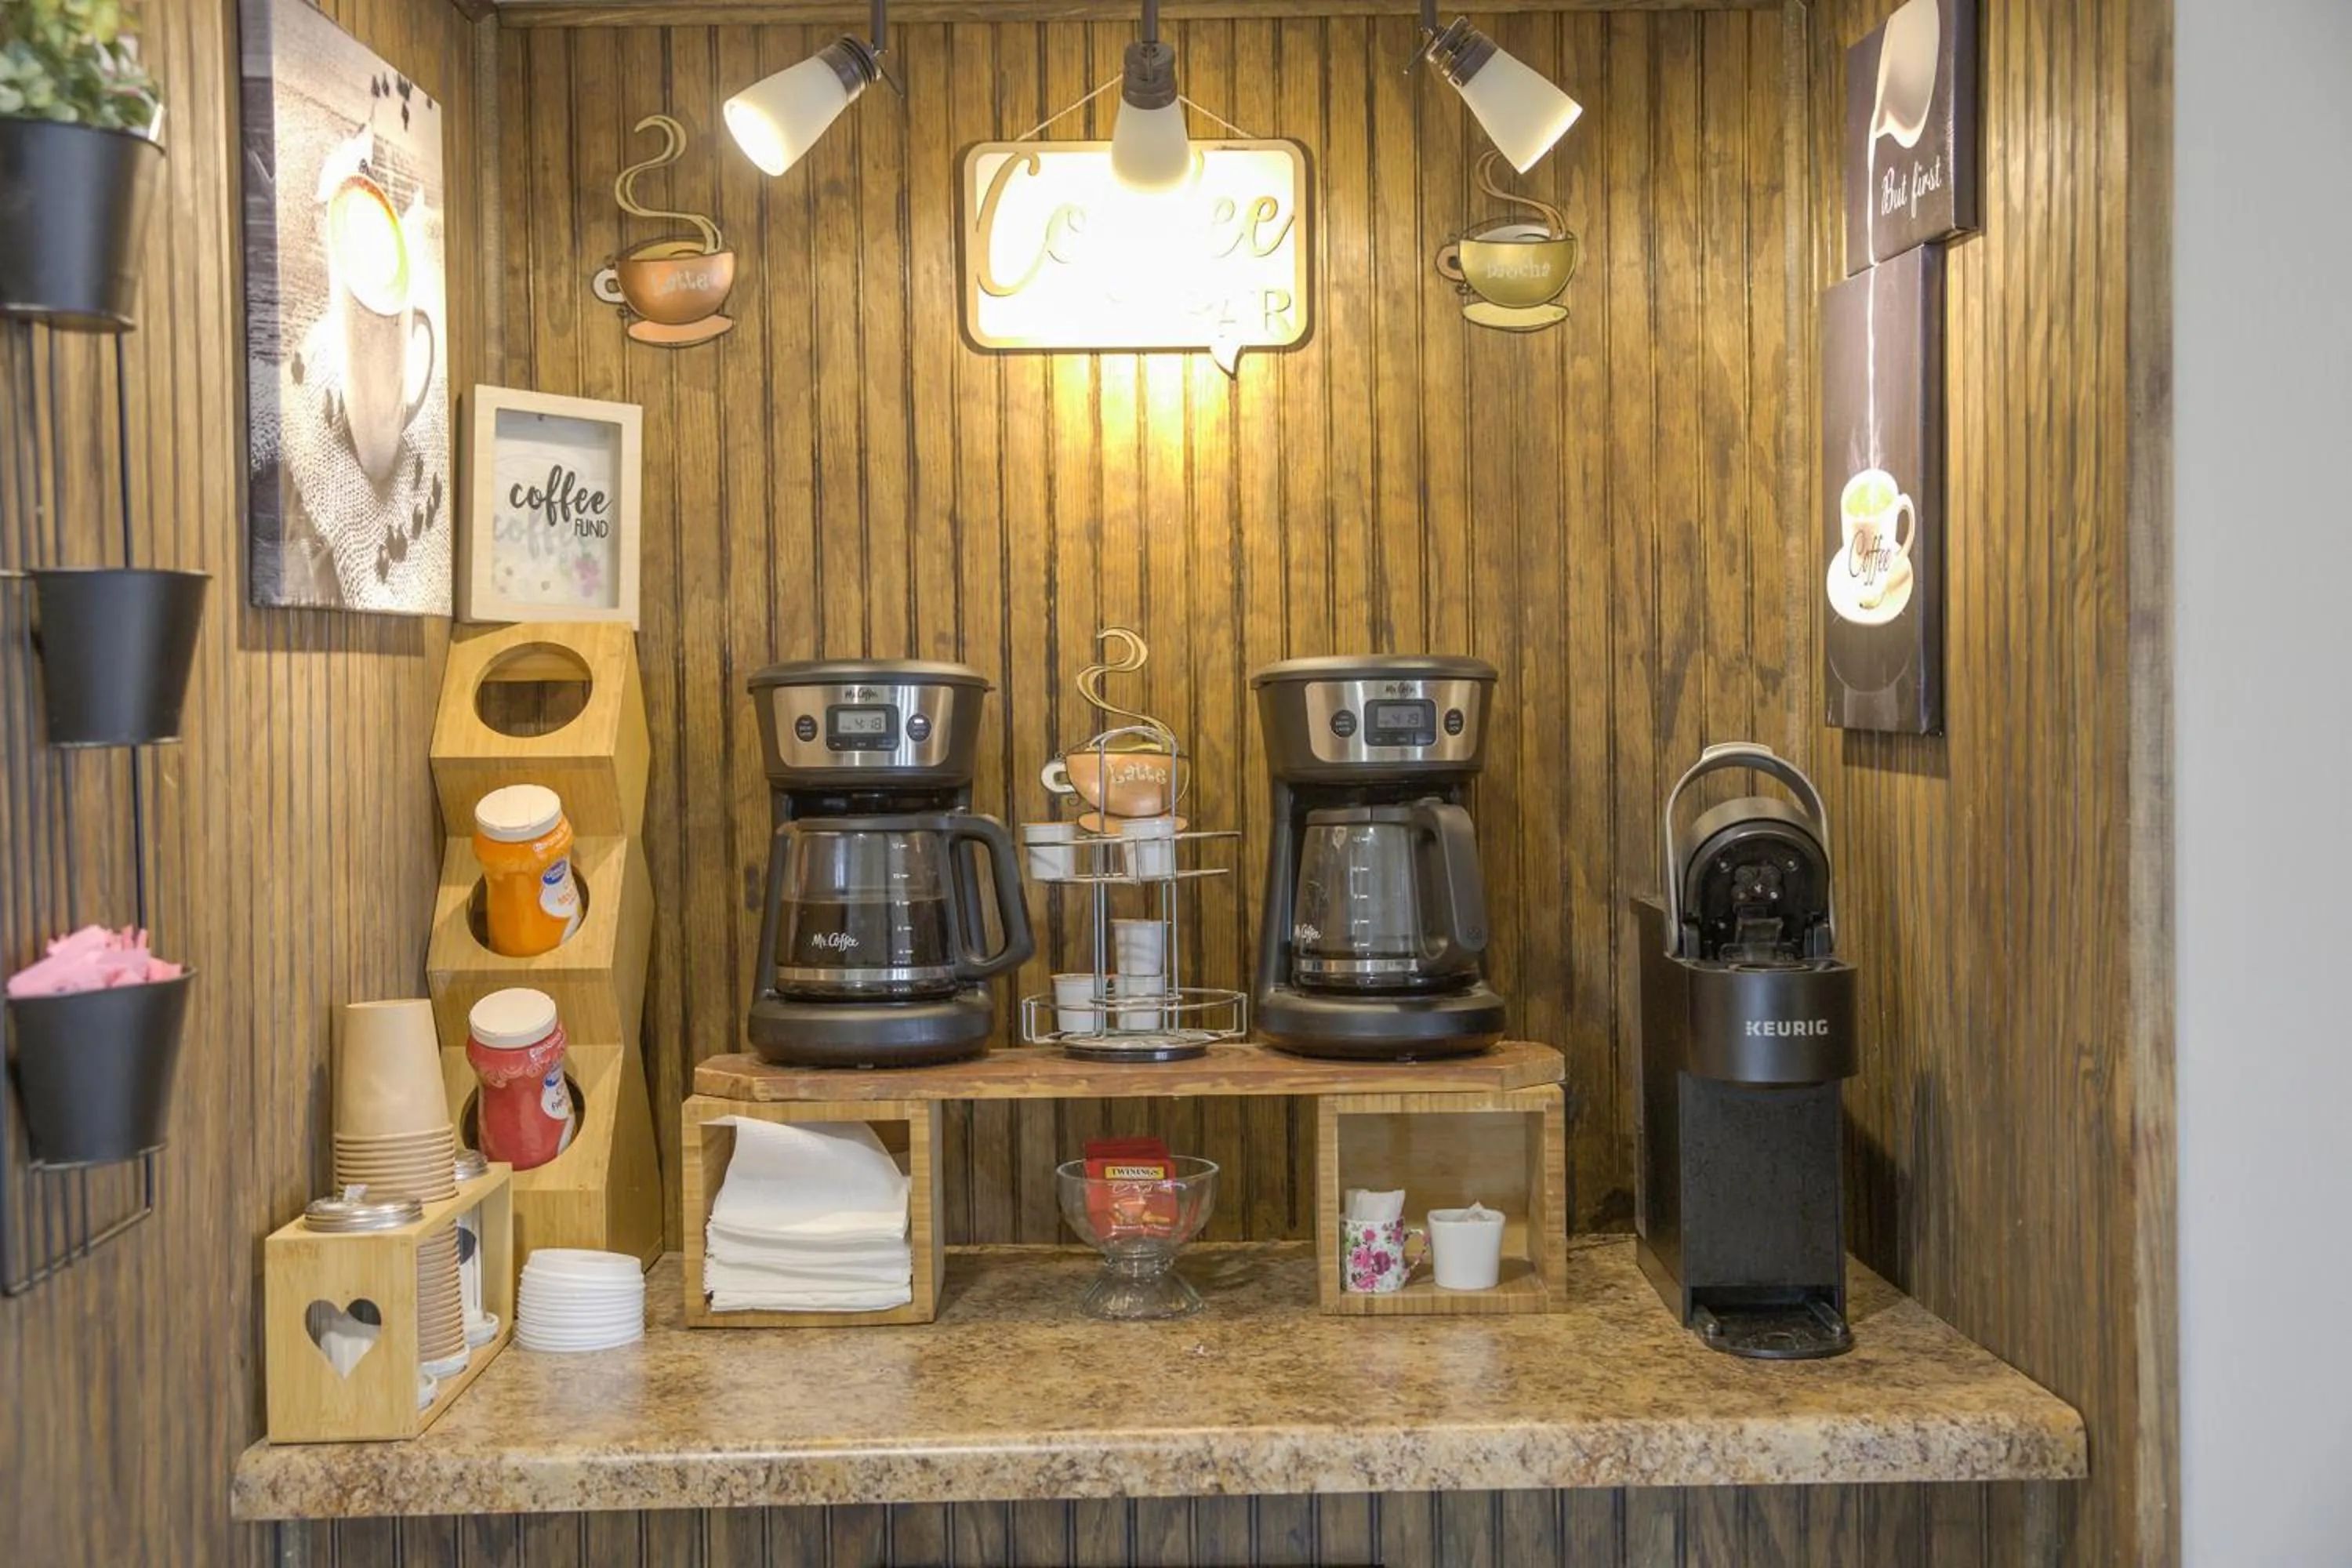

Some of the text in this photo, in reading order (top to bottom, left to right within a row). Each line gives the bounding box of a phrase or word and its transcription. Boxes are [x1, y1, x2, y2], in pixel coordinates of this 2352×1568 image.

[1882, 154, 1941, 219] But first
[509, 464, 613, 526] coffee
[575, 517, 608, 538] FUND
[1849, 530, 1892, 586] Coffee
[828, 932, 859, 952] Coffee
[1745, 1018, 1830, 1036] KEURIG
[1112, 1167, 1160, 1176] TWININGS
